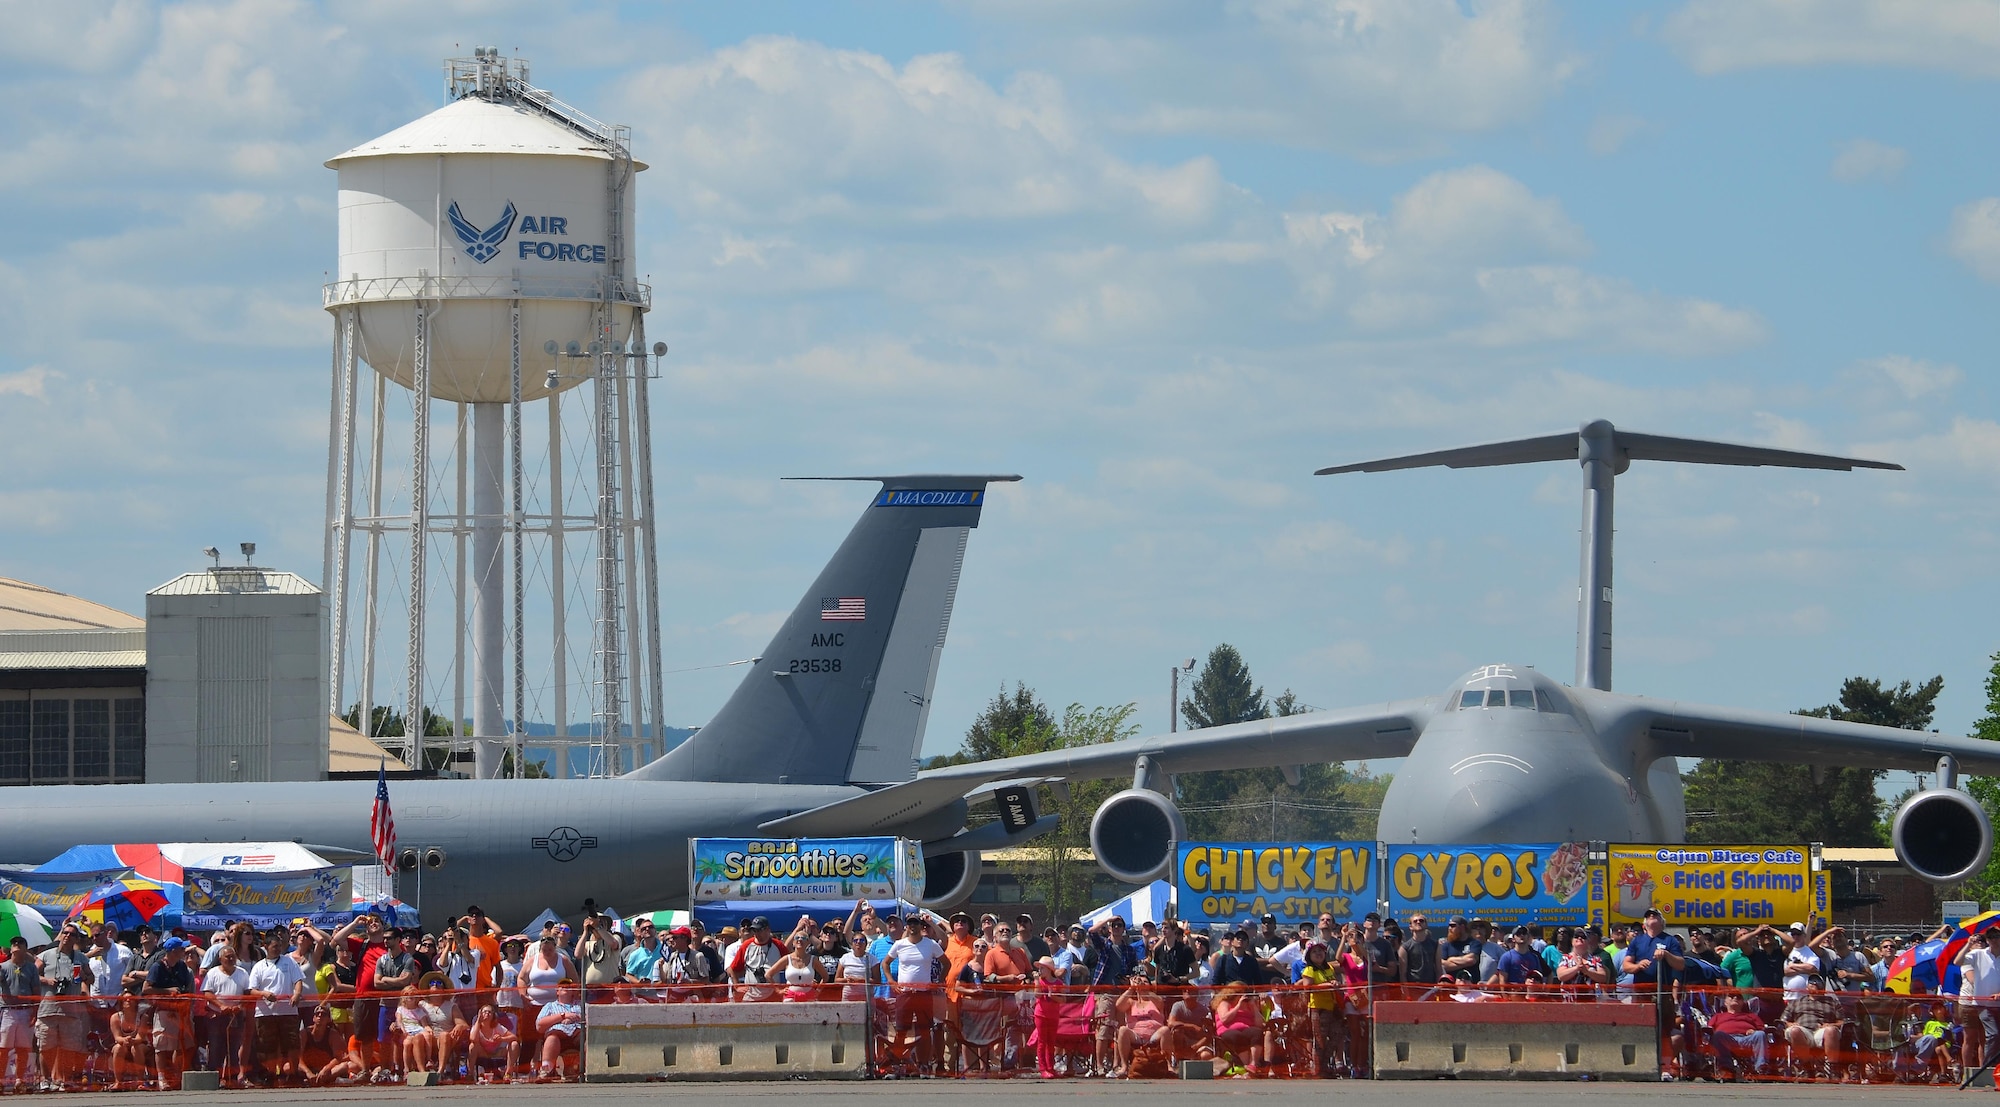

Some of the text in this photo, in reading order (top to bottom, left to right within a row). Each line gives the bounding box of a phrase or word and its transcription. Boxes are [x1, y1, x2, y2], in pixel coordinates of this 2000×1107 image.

[519, 215, 568, 235] AIR
[519, 241, 606, 264] FORCE
[894, 491, 967, 505] MACDILL
[811, 633, 844, 647] AMC
[789, 658, 842, 673] 23538
[1006, 794, 1027, 826] 6 AMW
[748, 841, 798, 854] BAJA
[1656, 849, 1803, 866] Cajun Blues Cafe
[723, 849, 868, 880] Smoothies
[1183, 846, 1371, 894] CHICKEN
[1393, 851, 1537, 902] GYROS
[1591, 869, 1604, 901] CRAB
[1674, 869, 1803, 893] Fried Shrimp
[2, 883, 48, 905] Blue
[220, 882, 314, 910] Blue Angels
[756, 885, 837, 894] WITH REAL FRUIT!
[1815, 874, 1827, 912] COCONUT
[1202, 896, 1353, 918] ON-A-STICK
[1674, 899, 1774, 918] Fried Fish
